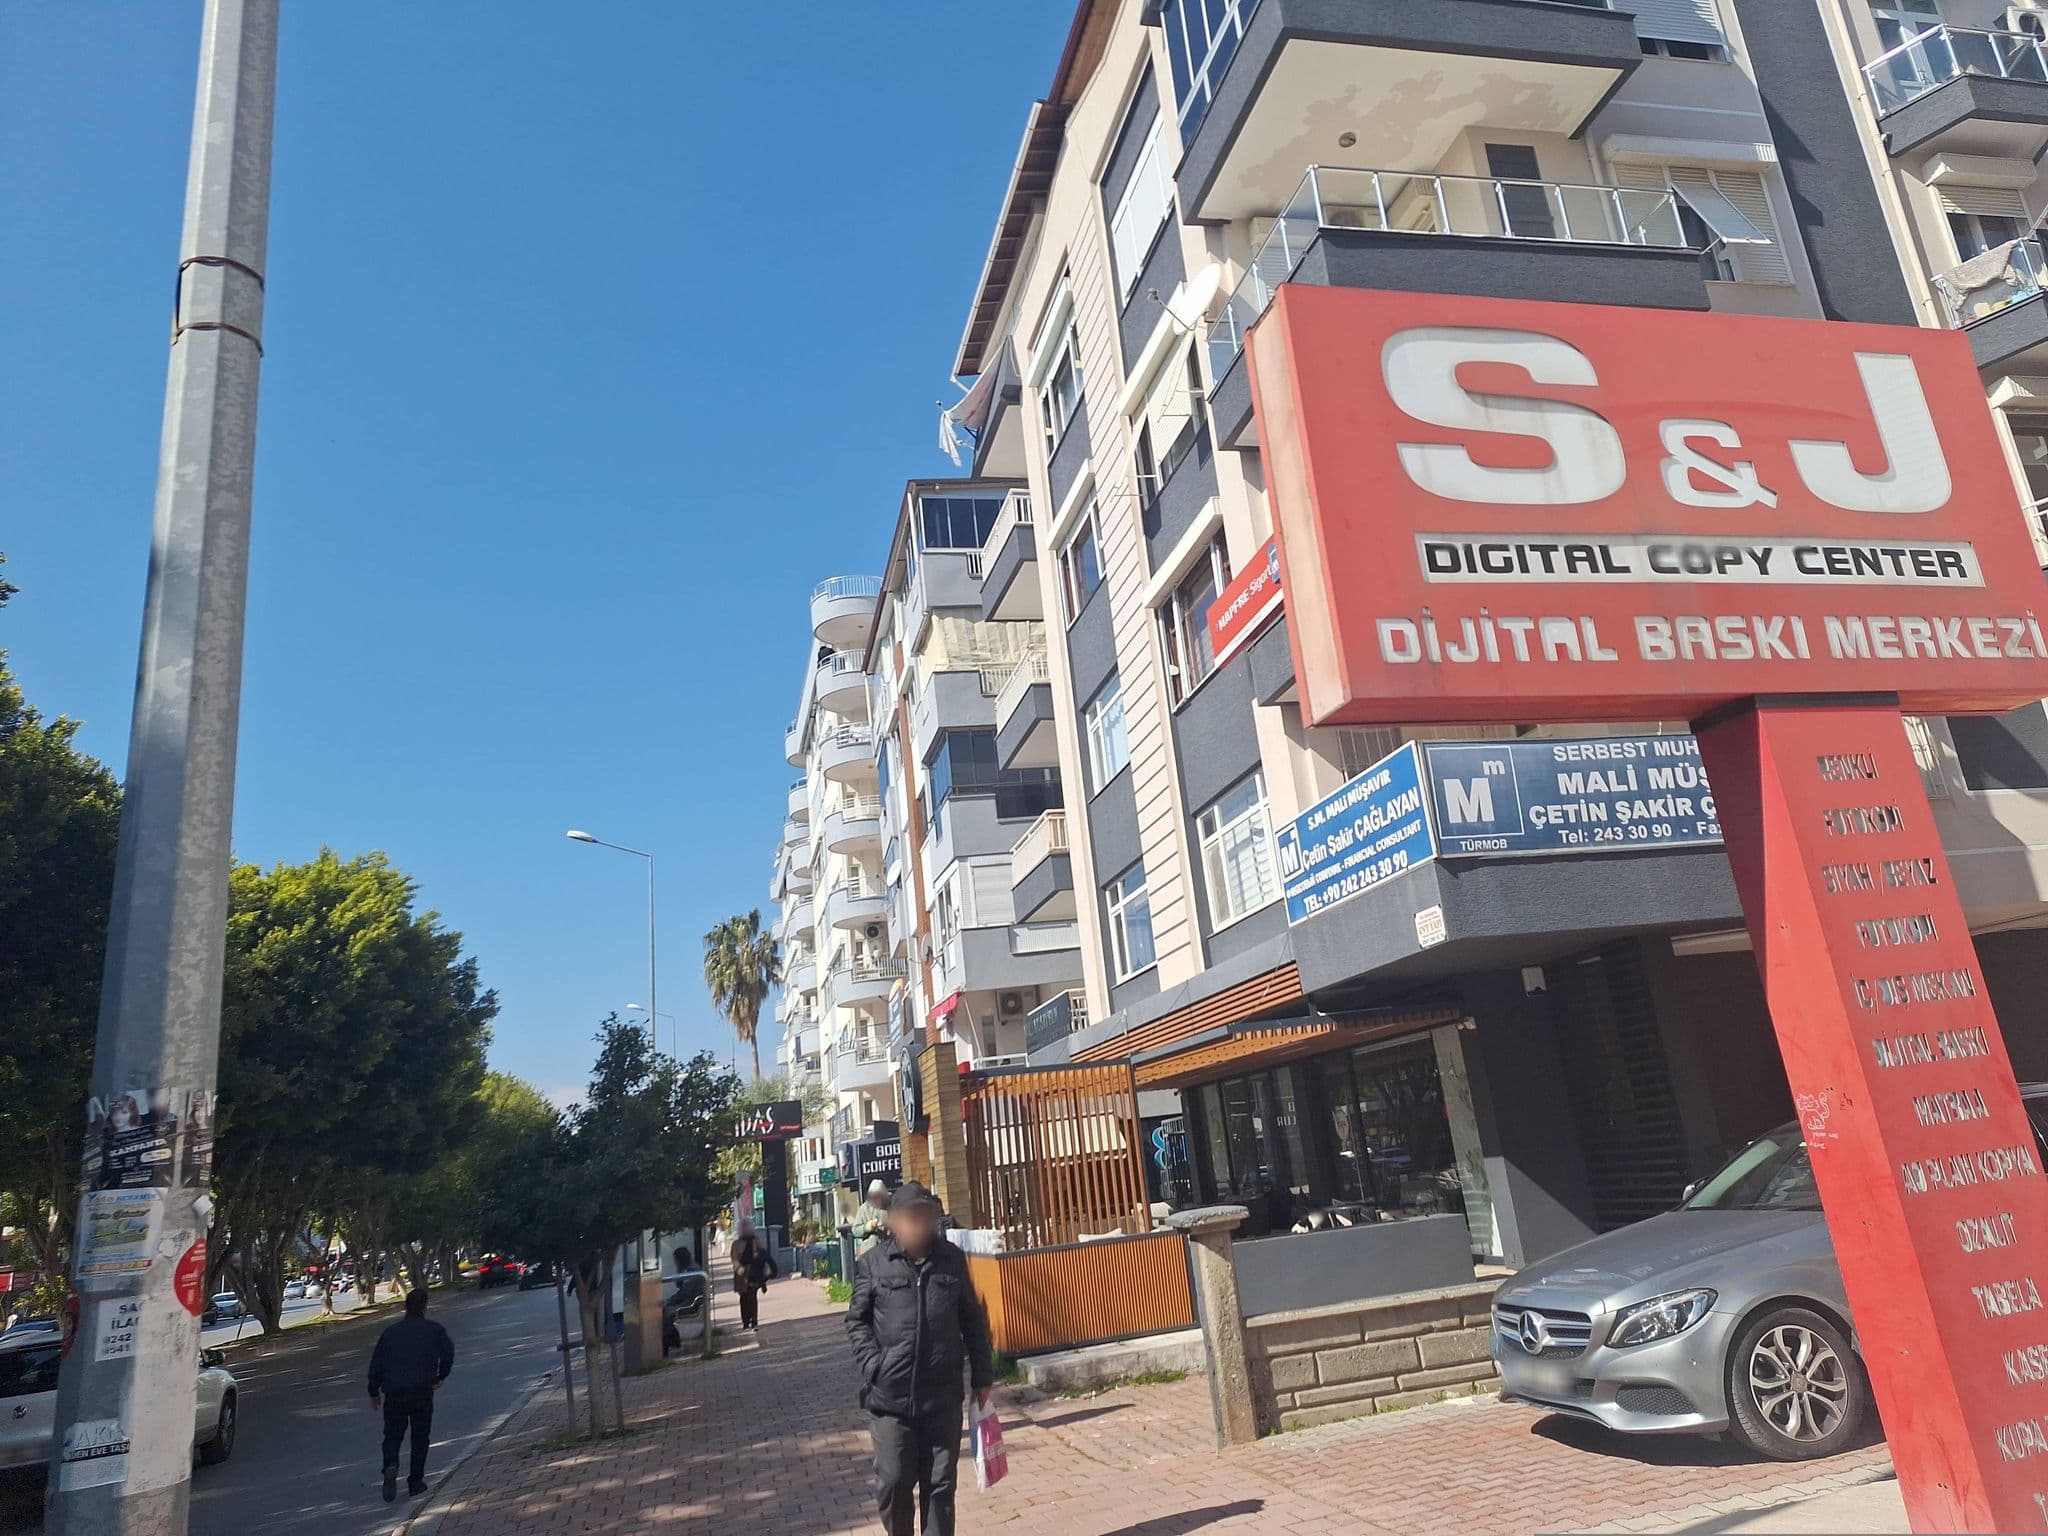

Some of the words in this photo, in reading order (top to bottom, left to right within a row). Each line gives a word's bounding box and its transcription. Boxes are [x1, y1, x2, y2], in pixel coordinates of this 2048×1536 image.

[1380, 326, 1626, 505] S
[1660, 419, 1778, 508] &
[1789, 352, 1952, 514] J
[1426, 543, 1630, 576] DIGITAL
[1647, 545, 1773, 577] COPY
[1796, 545, 1966, 579] CENTER
[1376, 606, 1620, 665] DİJİTAL
[1633, 615, 1811, 662] BASKI
[1828, 608, 2048, 660] MERKEZİ
[1553, 741, 1648, 762] SERBEST
[1653, 740, 1700, 757] MUH
[1557, 764, 1638, 796] MALİ
[1301, 843, 1328, 871] Çetin
[1353, 787, 1421, 842] ÇAĞLAYAN
[1529, 799, 1608, 830] ÇETİN
[1615, 794, 1695, 825] ŞAKİR
[1460, 838, 1508, 851] TÜRMOB
[1558, 829, 1588, 844] Tel:
[1594, 827, 1624, 842] 243
[1628, 825, 1648, 839] 30
[1652, 823, 1672, 838] 90
[1340, 874, 1358, 896] 242
[1359, 866, 1378, 889] 243
[1392, 850, 1408, 869] 90
[1912, 1088, 1990, 1127] MATBAA
[1975, 1145, 2037, 1182] KOPYA
[1971, 1275, 2043, 1320] TABELA
